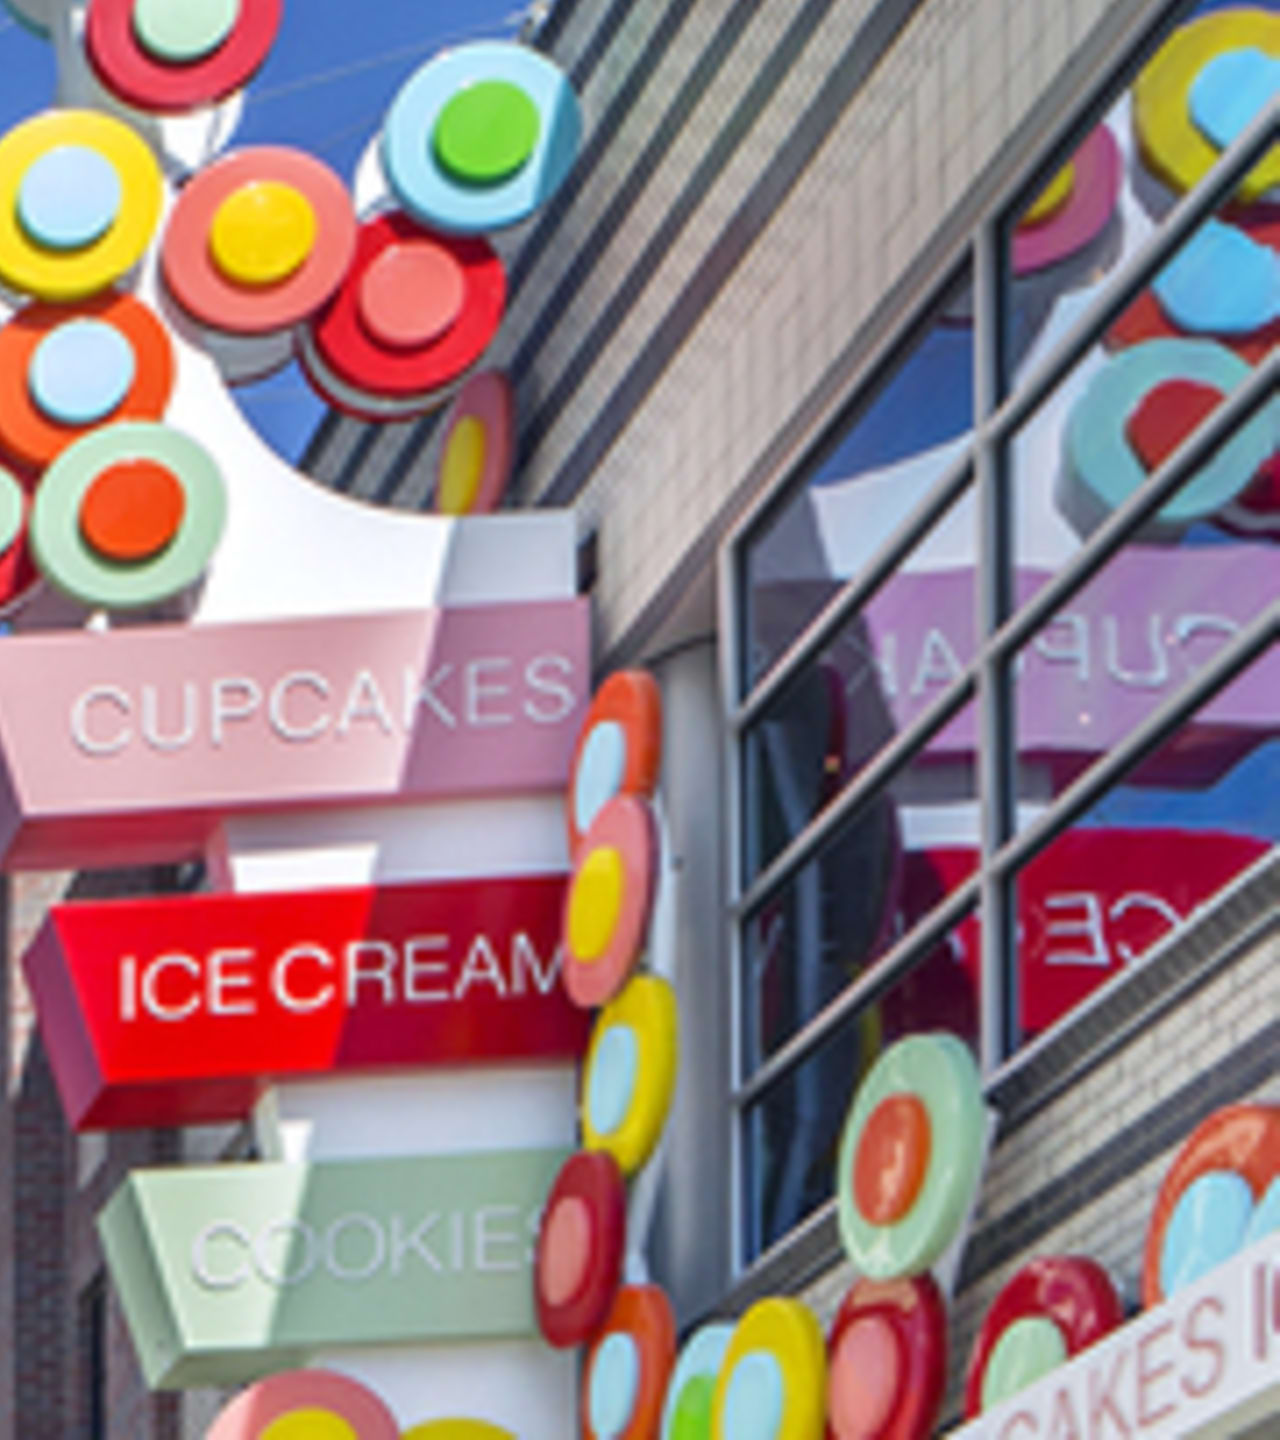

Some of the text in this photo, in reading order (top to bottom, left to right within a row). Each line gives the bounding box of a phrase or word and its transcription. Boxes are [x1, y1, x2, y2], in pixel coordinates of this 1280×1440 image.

[72, 654, 578, 755] CUPCAKES
[118, 932, 564, 1022] ICE CREAM
[191, 1203, 544, 1292] COOKIE
